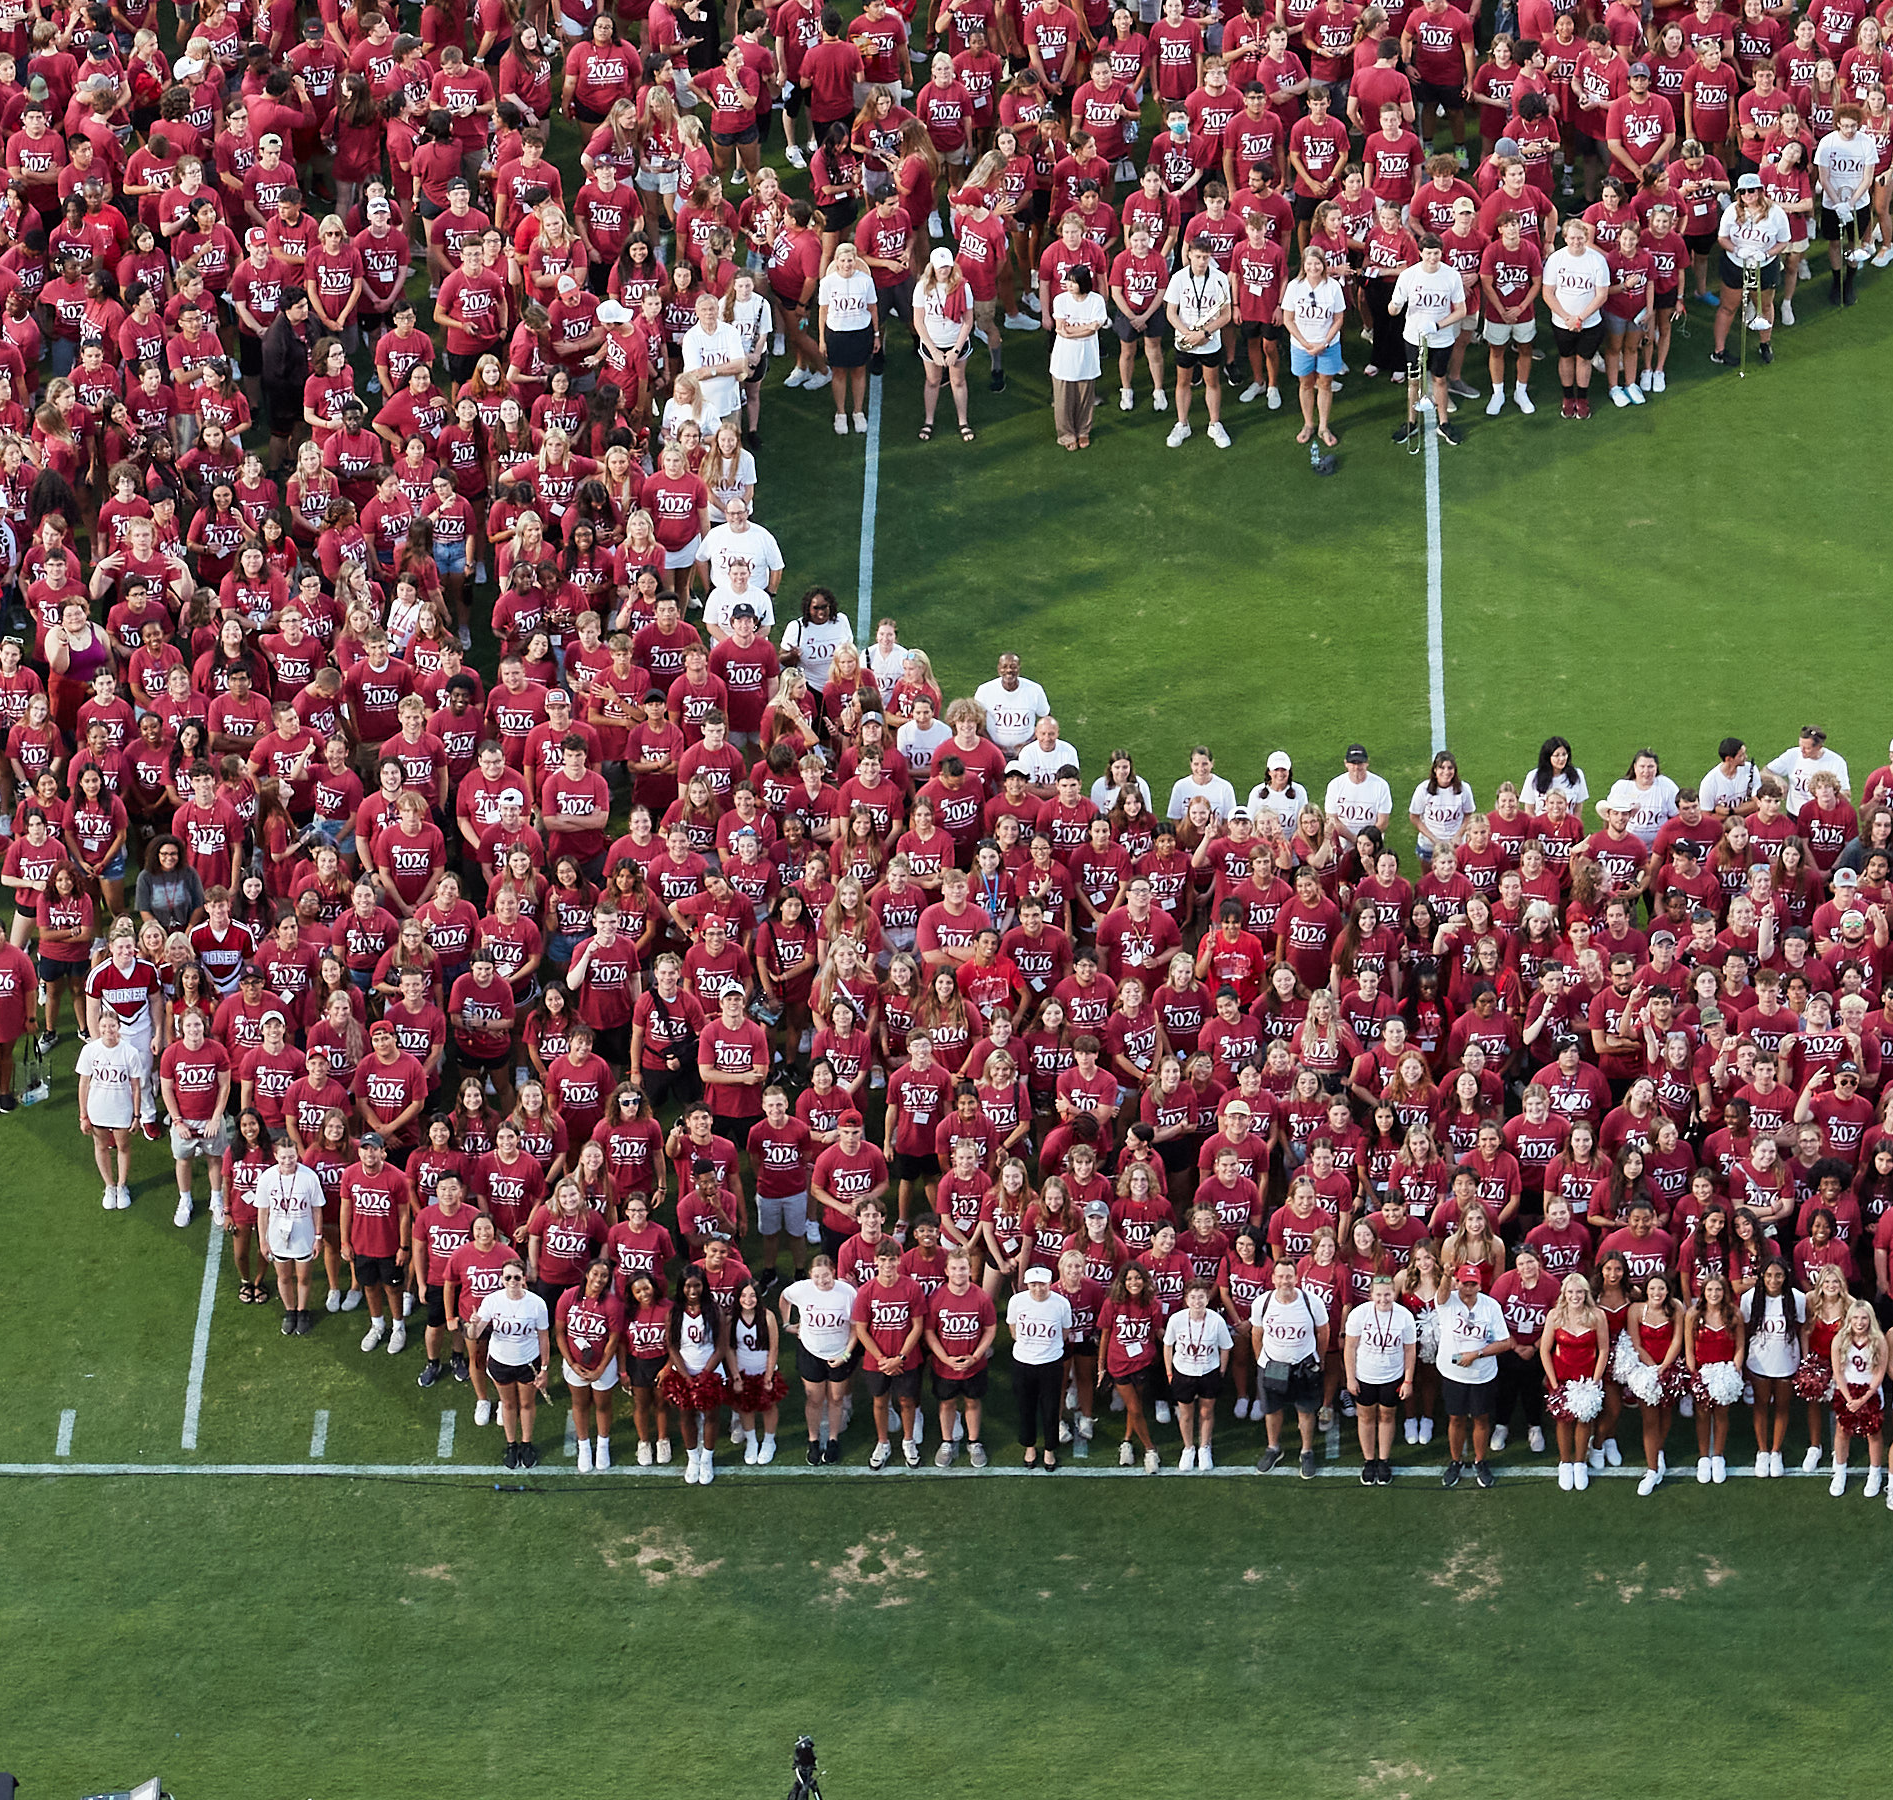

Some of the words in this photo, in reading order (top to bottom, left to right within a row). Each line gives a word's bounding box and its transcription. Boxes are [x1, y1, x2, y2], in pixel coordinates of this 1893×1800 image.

[1419, 30, 1454, 45] 2026
[1161, 44, 1191, 58] 2026
[588, 62, 624, 77] 2026
[1695, 88, 1729, 103] 2026
[1377, 157, 1409, 172] 2026
[1831, 158, 1863, 172] 2026
[590, 208, 622, 224] 2026
[1559, 275, 1592, 289] 2026
[833, 298, 865, 310] 2026
[1416, 292, 1448, 308] 2026
[656, 496, 694, 512] 2026
[276, 662, 311, 676] 2026
[728, 668, 762, 684] 2026
[364, 689, 398, 704] 2026
[495, 713, 535, 729] 2026
[995, 711, 1030, 728] 2026
[559, 799, 594, 815] 2026
[1338, 804, 1373, 820] 2026
[1427, 808, 1461, 822] 2026
[393, 852, 429, 868] 2026
[661, 880, 698, 897] 2026
[593, 966, 628, 982] 2026
[1166, 1012, 1201, 1026] 2026
[1803, 1038, 1843, 1052] 2026
[715, 1048, 753, 1065] 2026
[93, 1068, 127, 1082] 2026
[178, 1069, 216, 1084] 2026
[257, 1074, 295, 1090] 2026
[367, 1082, 405, 1100] 2026
[563, 1087, 599, 1102] 2026
[612, 1141, 648, 1157] 2026
[764, 1146, 800, 1162] 2026
[1518, 1142, 1557, 1159] 2026
[489, 1181, 524, 1198] 2026
[837, 1175, 871, 1191] 2026
[807, 1312, 845, 1328] 2026
[873, 1306, 909, 1322] 2026
[493, 1320, 532, 1336] 2026
[941, 1316, 979, 1332] 2026
[1018, 1322, 1056, 1338] 2026
[1266, 1324, 1306, 1340] 2026
